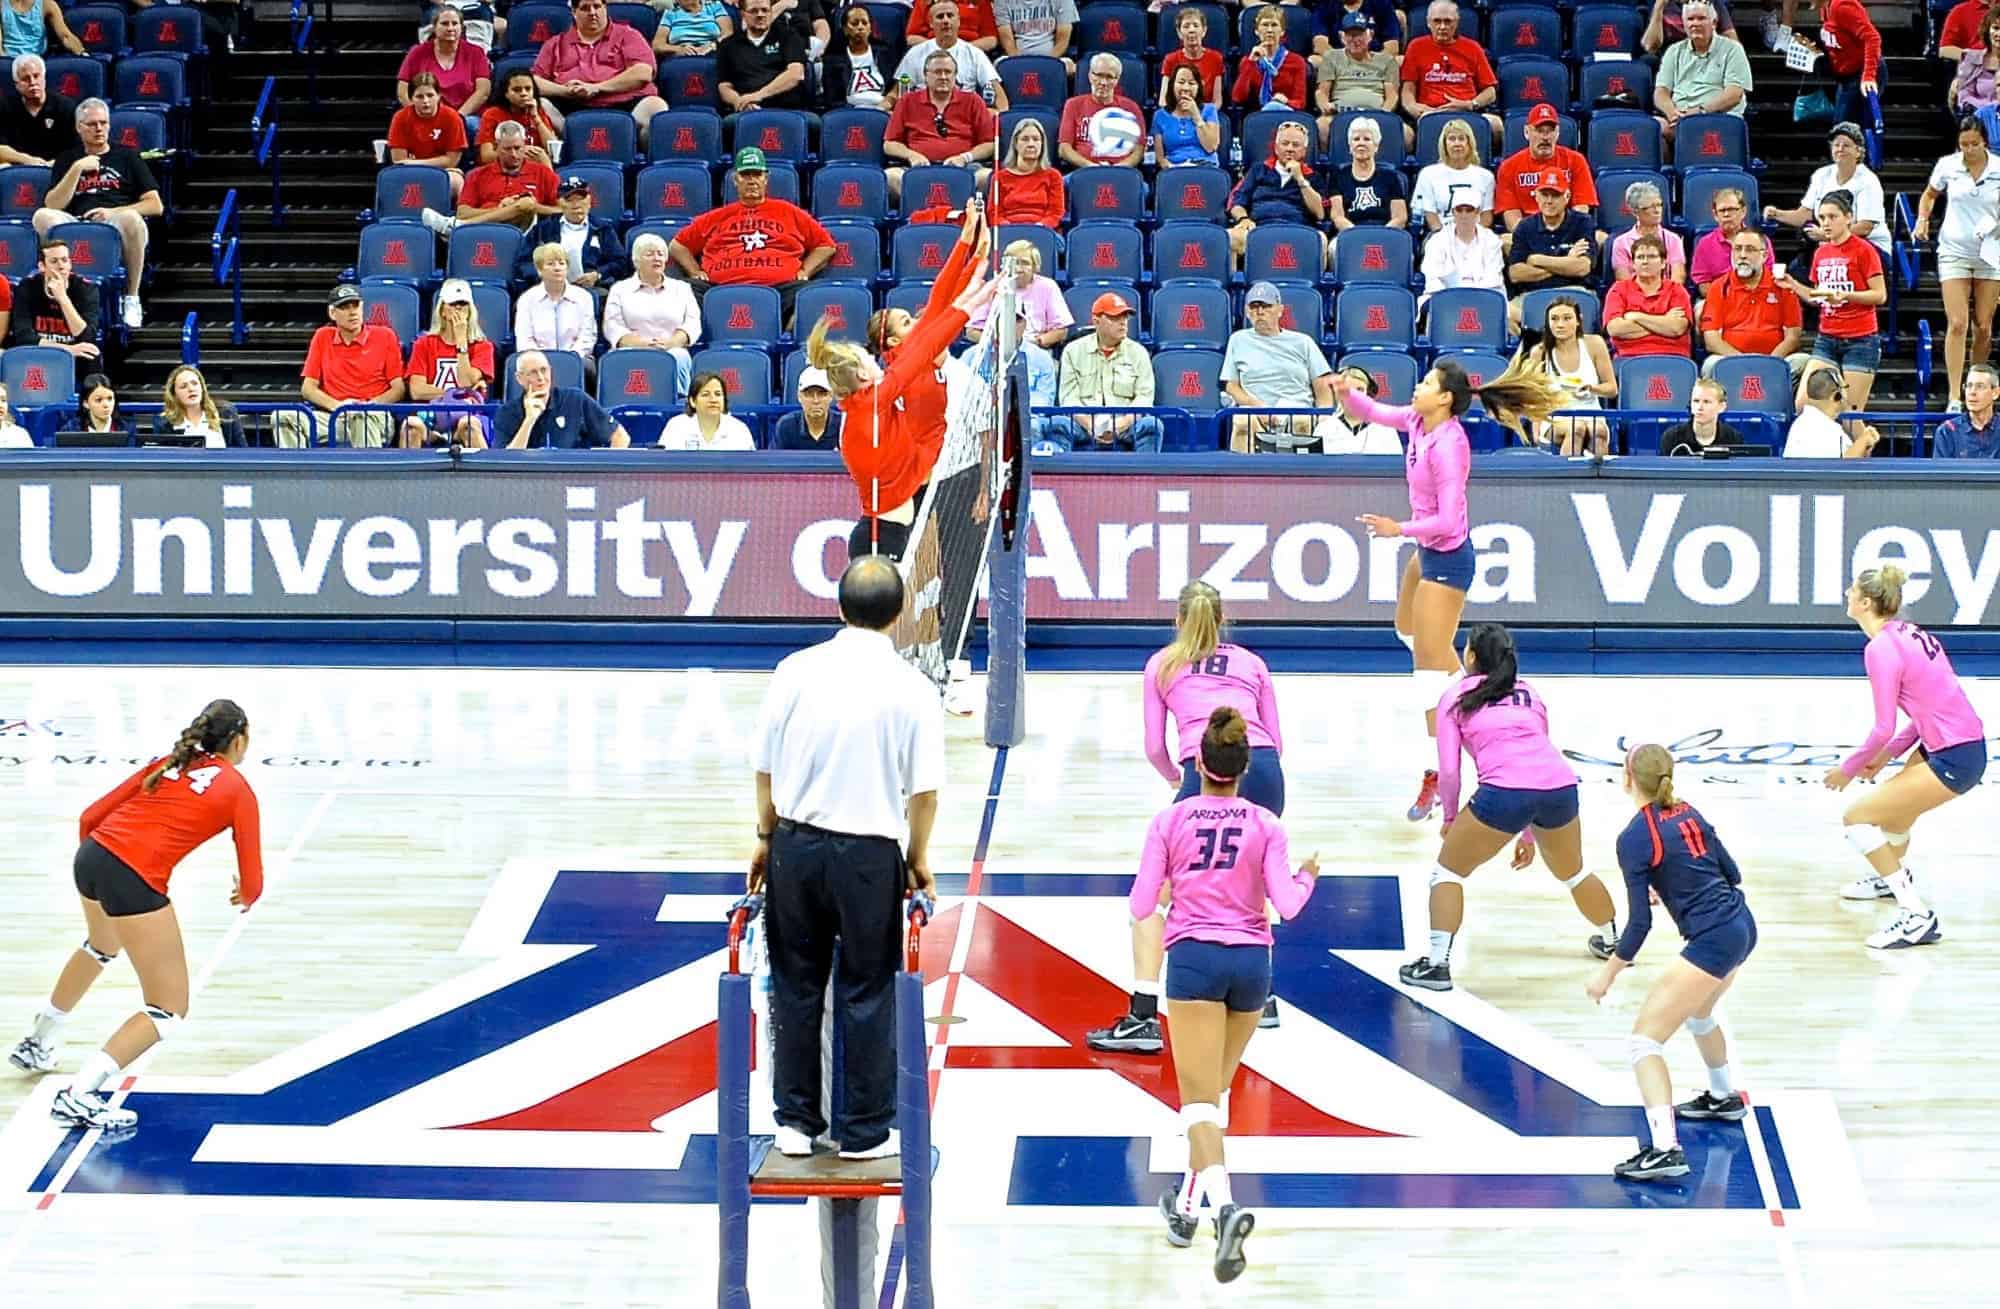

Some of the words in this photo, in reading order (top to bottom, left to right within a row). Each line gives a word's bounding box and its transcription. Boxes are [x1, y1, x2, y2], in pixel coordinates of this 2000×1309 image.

[19, 484, 748, 617] University
[1187, 808, 1249, 821] ARIZONA
[1188, 826, 1242, 872] 35
[1677, 818, 1707, 860] 11
